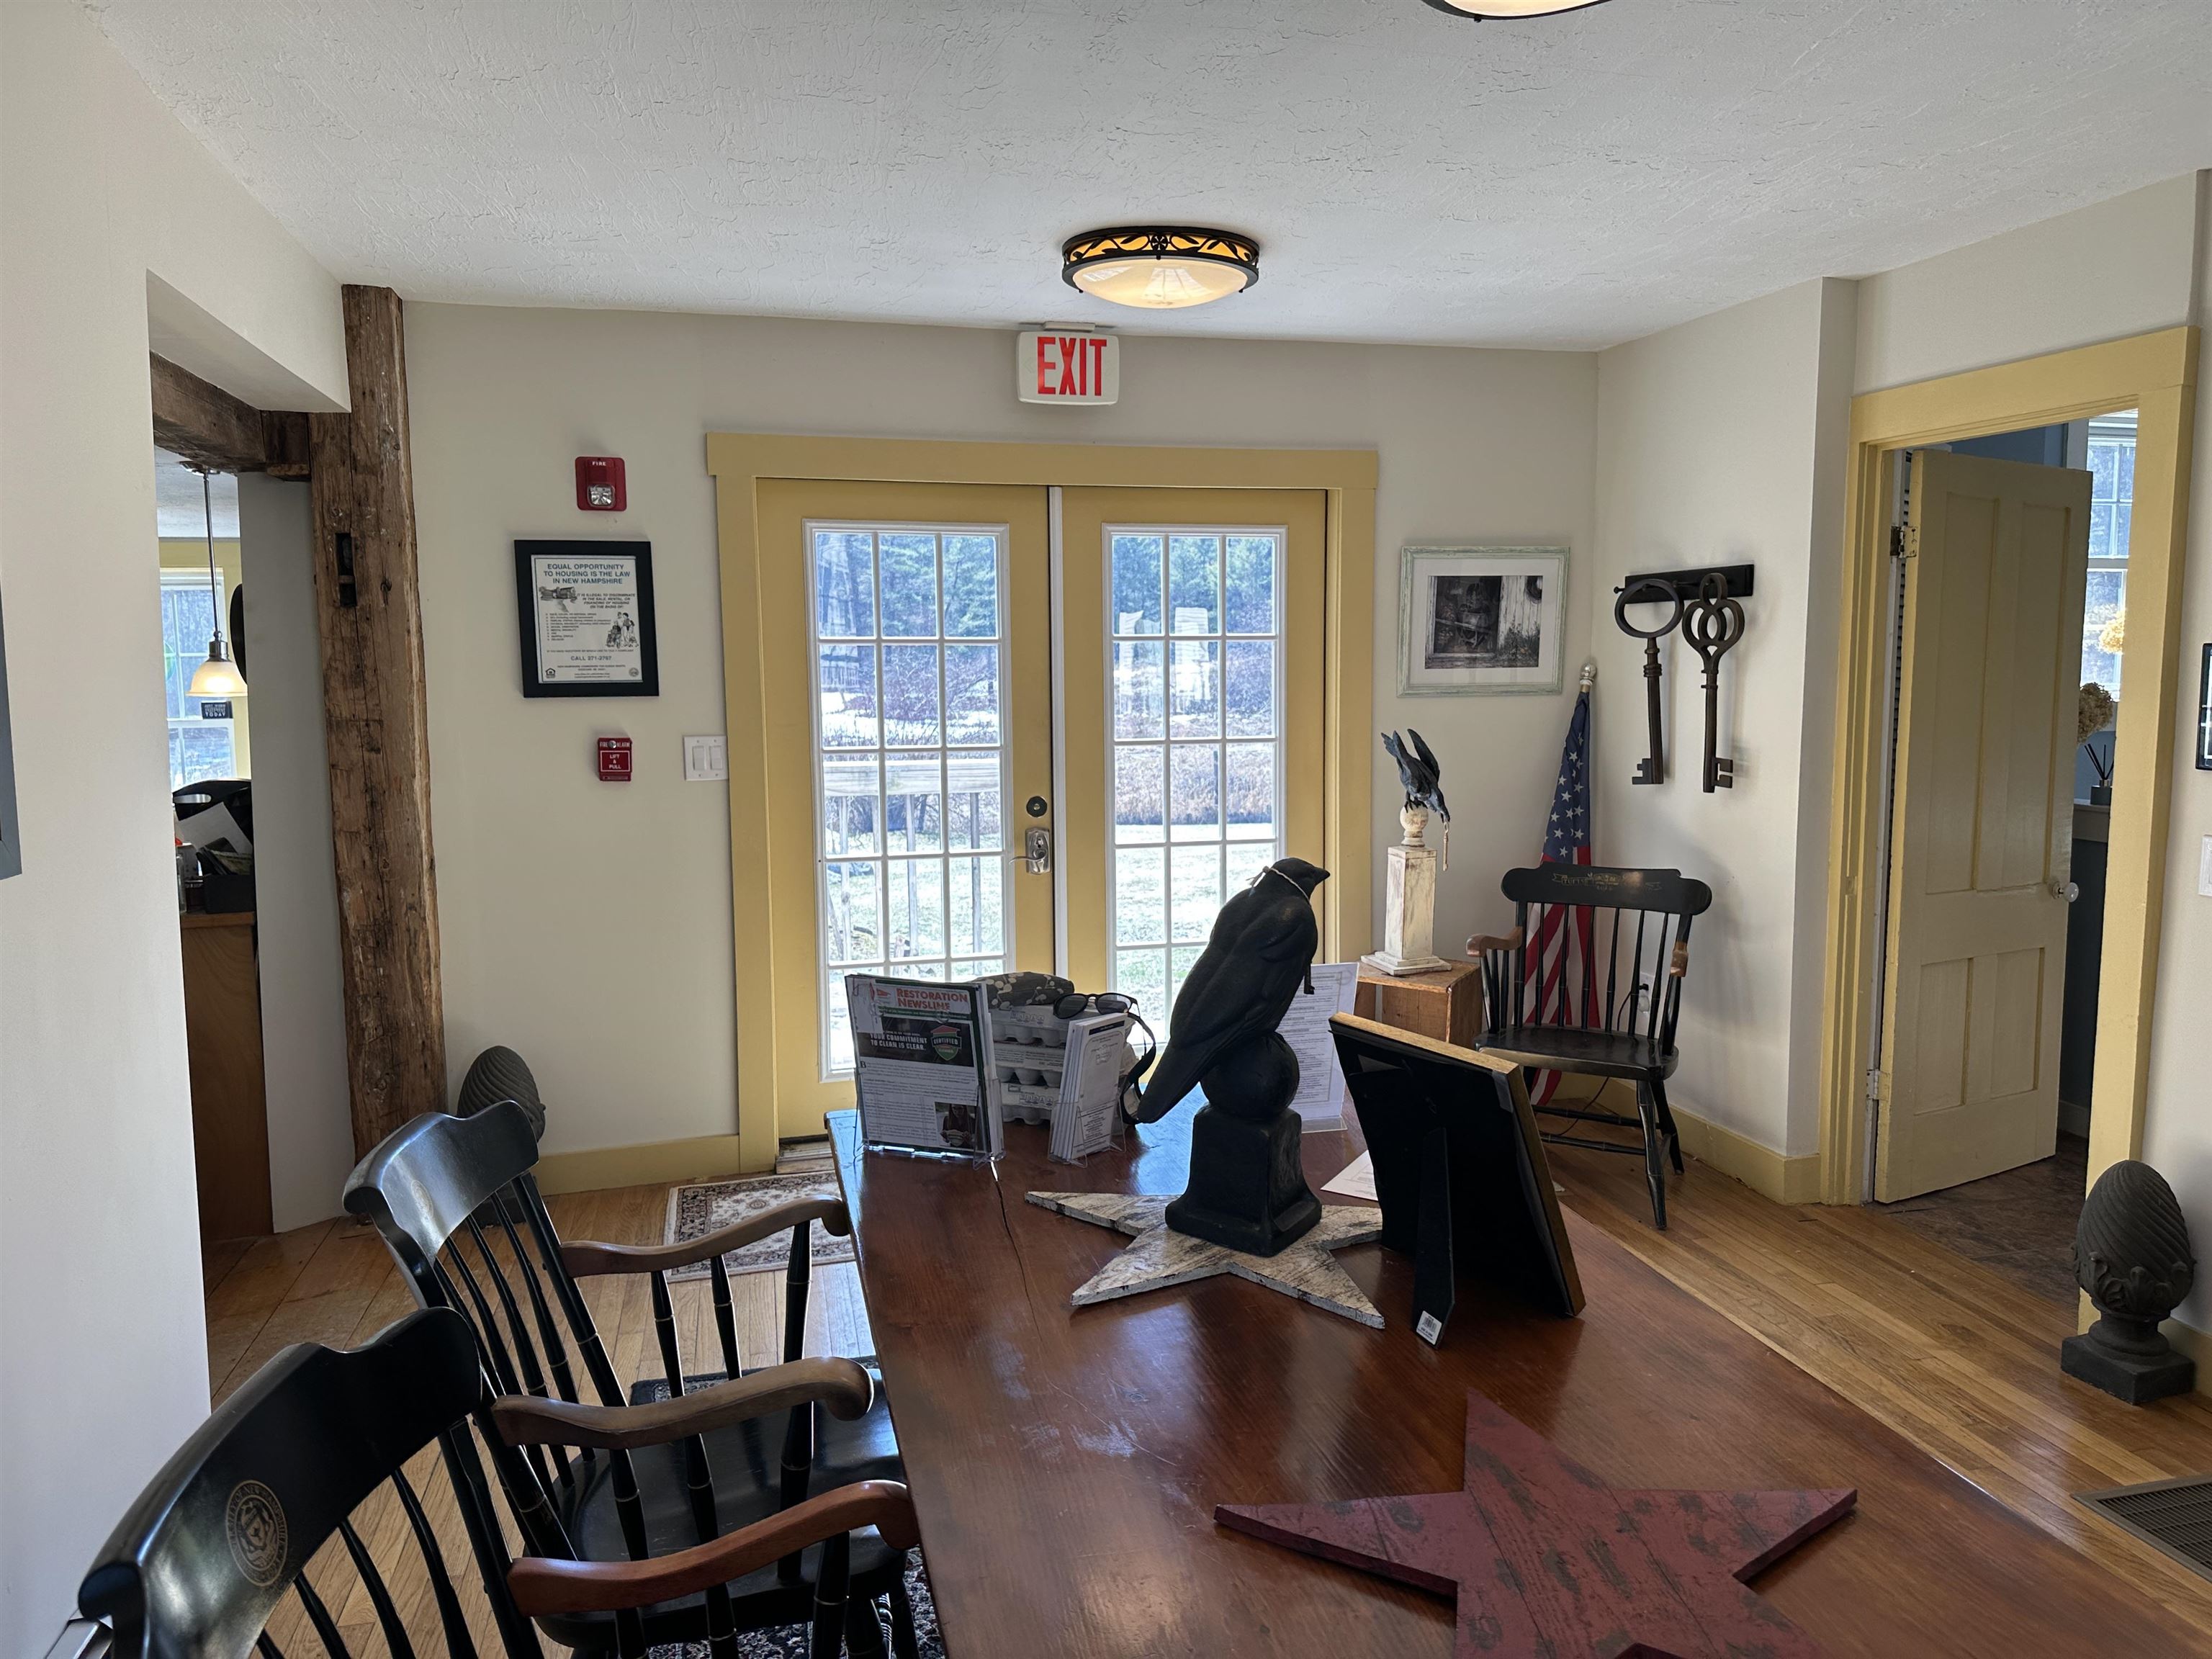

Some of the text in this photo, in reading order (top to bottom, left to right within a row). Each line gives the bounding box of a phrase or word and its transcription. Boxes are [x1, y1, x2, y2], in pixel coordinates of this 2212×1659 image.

[1037, 336, 1107, 397] EXIT
[896, 988, 968, 1003] RESTORATION
[897, 998, 950, 1010] NEWSLINE
[886, 1034, 927, 1044] COMMITMENT
